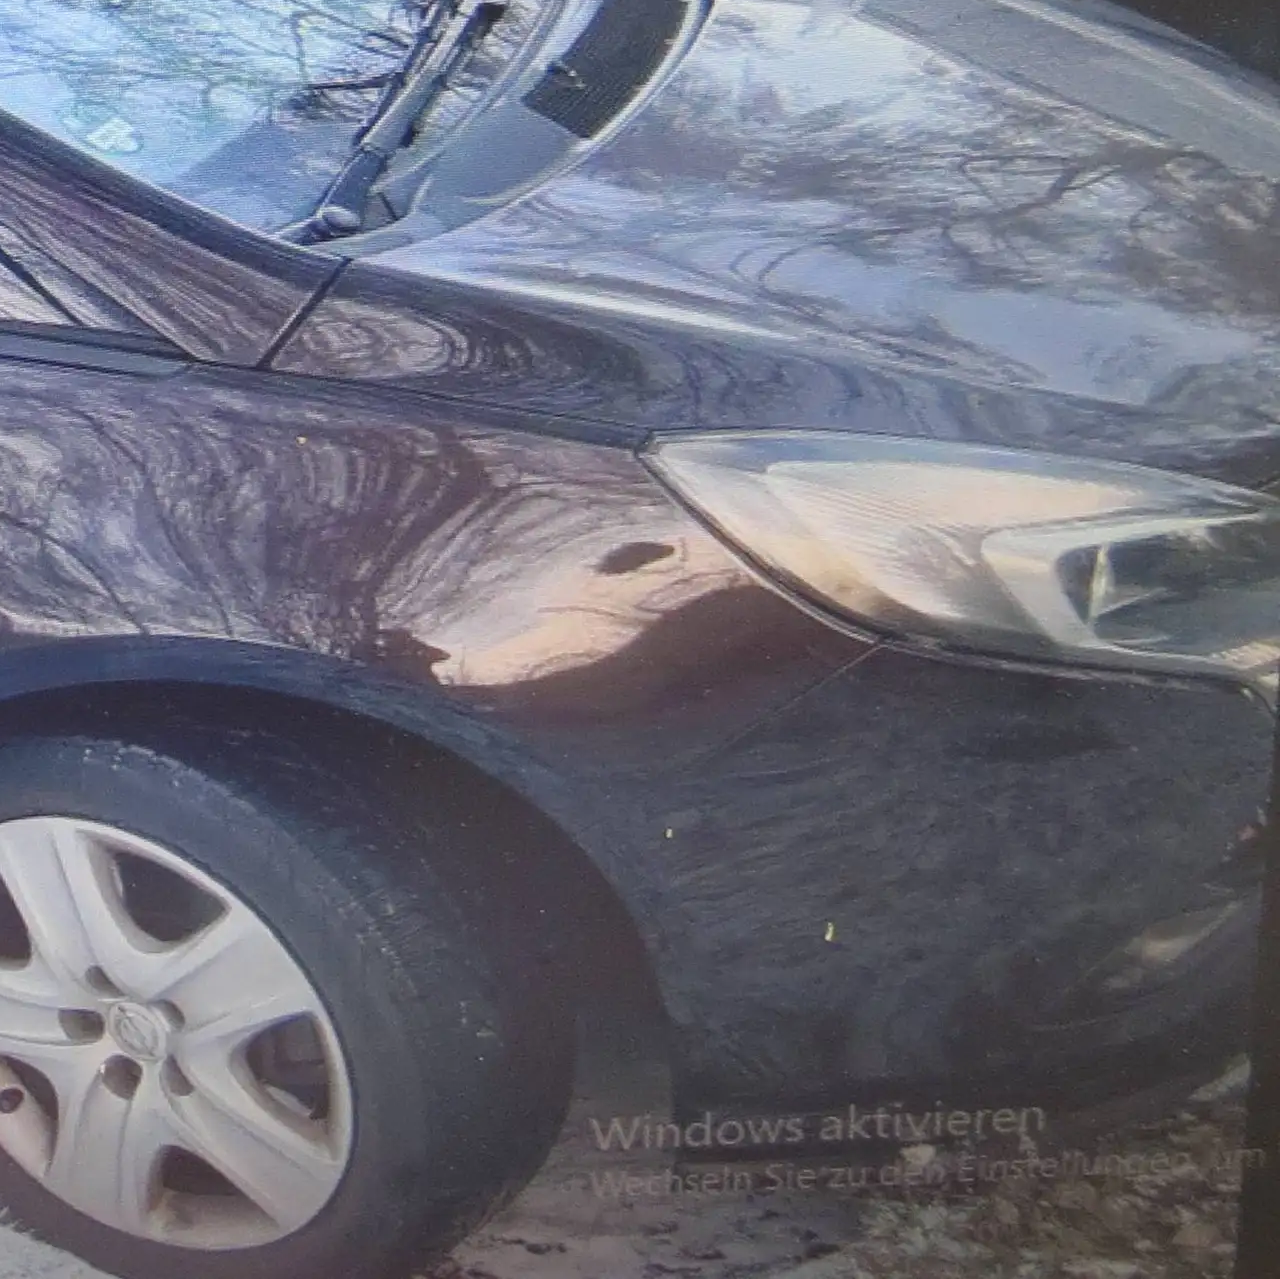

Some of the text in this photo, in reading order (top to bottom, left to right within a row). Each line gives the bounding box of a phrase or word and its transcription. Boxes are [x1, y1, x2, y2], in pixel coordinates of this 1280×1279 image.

[589, 1101, 1046, 1151] Windows aktivieren
[590, 1165, 753, 1199] Wechseln
[764, 1162, 817, 1191] Sie
[826, 1167, 868, 1190] zu
